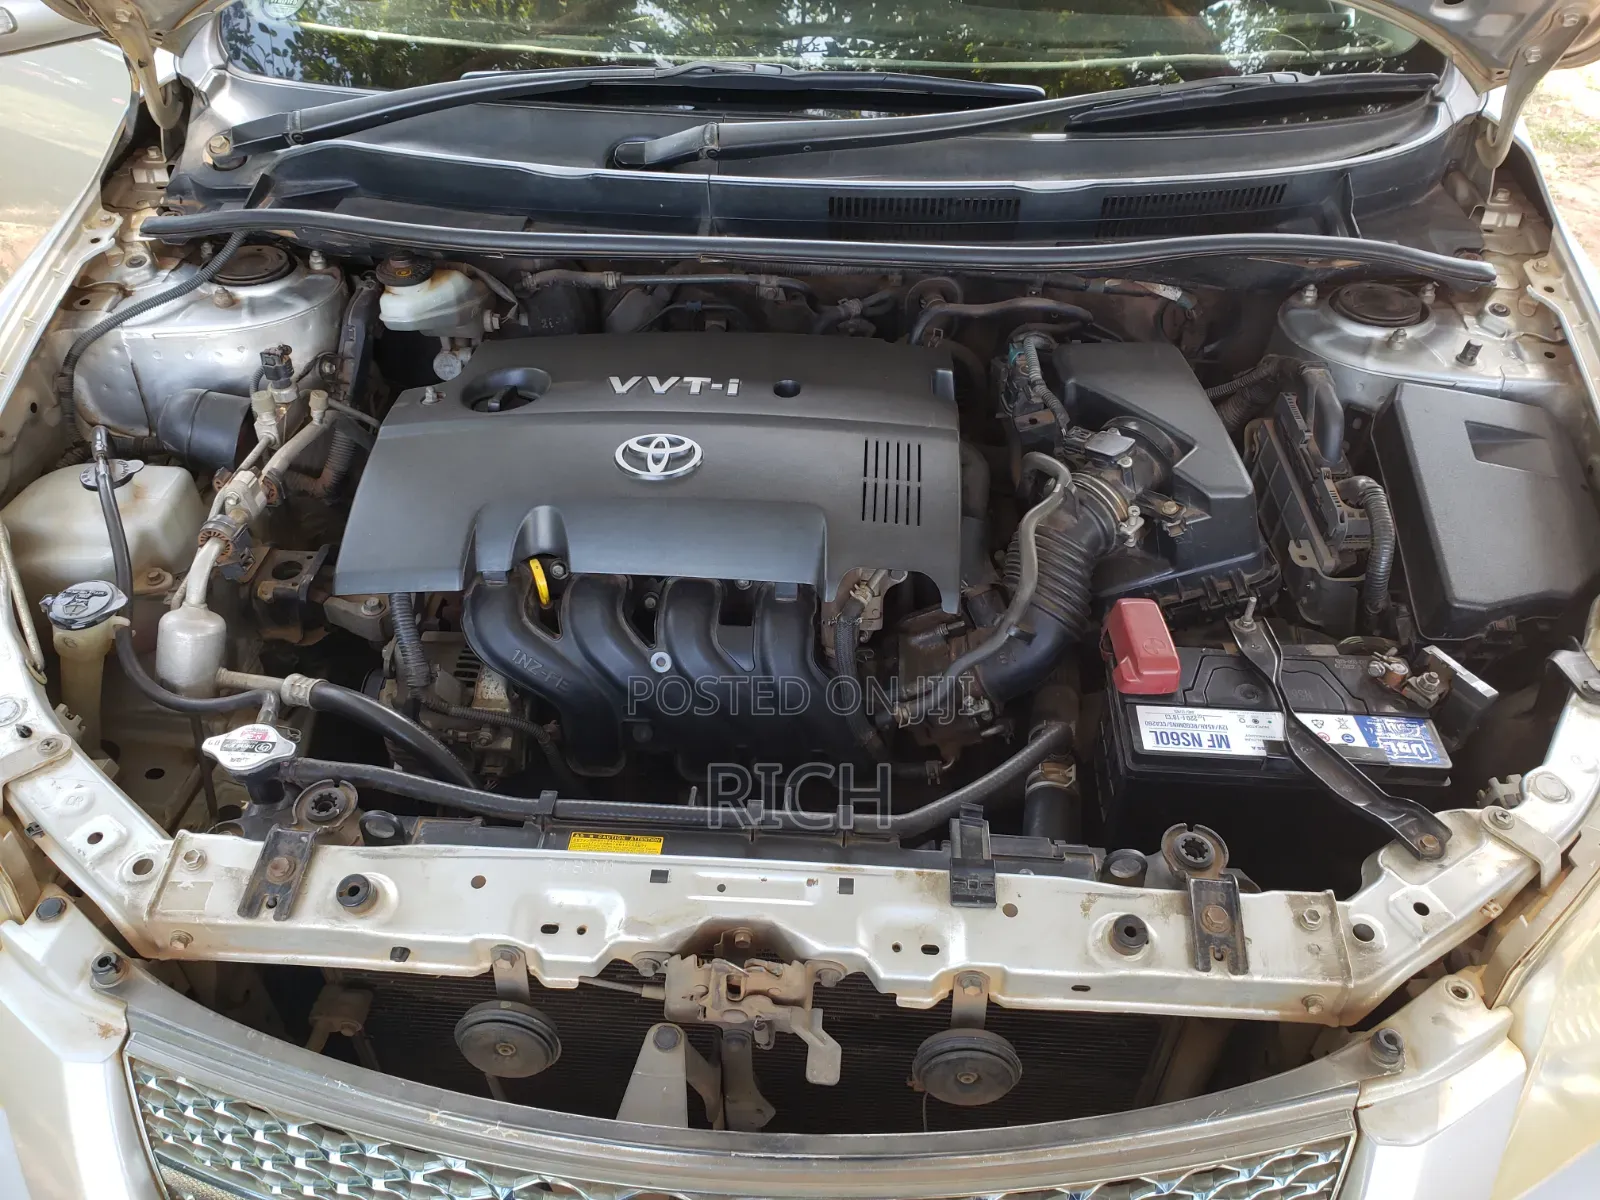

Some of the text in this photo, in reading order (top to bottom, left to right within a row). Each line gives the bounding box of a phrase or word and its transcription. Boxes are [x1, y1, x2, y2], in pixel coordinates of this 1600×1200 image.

[608, 375, 740, 396] VVT-i
[511, 649, 573, 694] 1NZ-FE
[1149, 730, 1203, 748] NS60L
[1207, 733, 1231, 749] MF
